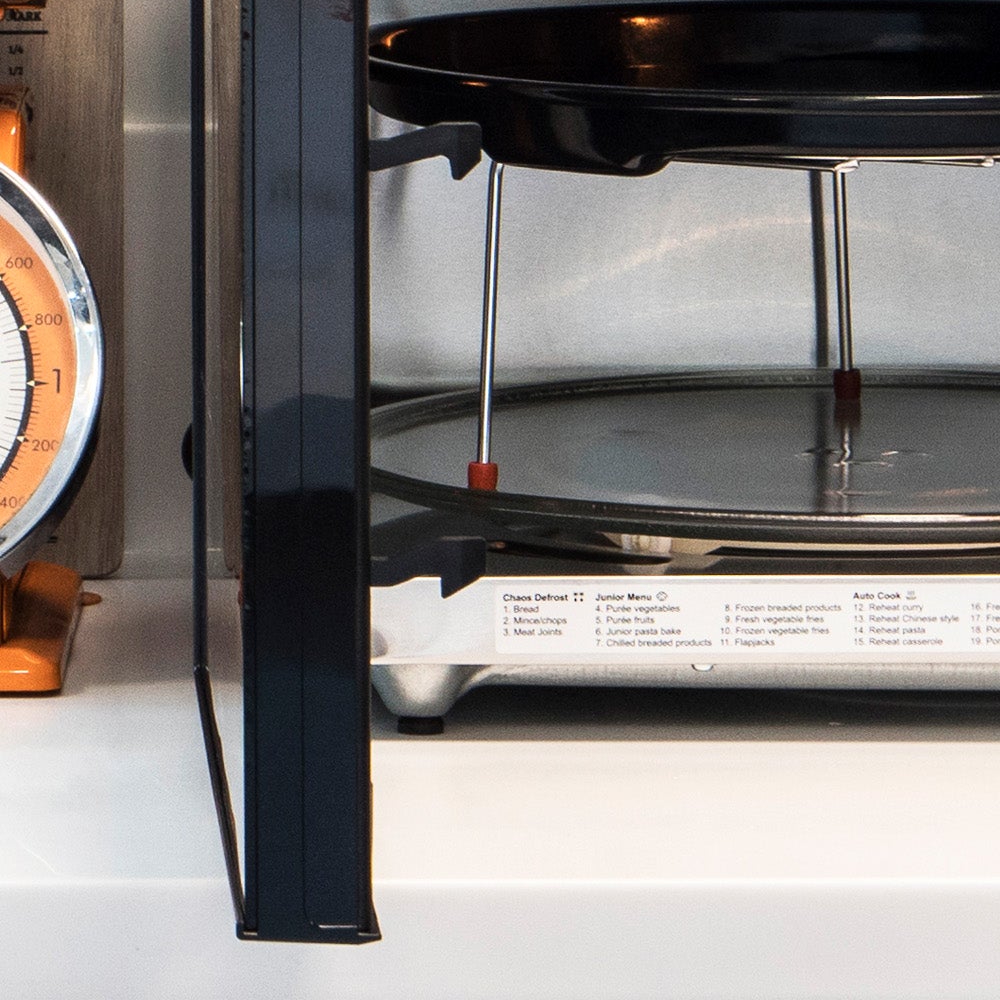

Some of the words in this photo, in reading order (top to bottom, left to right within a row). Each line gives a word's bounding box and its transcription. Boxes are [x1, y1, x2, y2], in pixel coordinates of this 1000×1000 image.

[6, 257, 33, 269] 600
[34, 313, 62, 326] 800
[52, 369, 61, 393] 1
[502, 593, 532, 602] Chaos
[534, 593, 569, 602] Defrost
[595, 592, 625, 602] Junior
[627, 592, 652, 602] Menu
[853, 592, 875, 600] Auto
[877, 592, 901, 600] Cook
[513, 604, 539, 614] Bread
[606, 604, 632, 613] Purée
[634, 604, 680, 614] vegetables
[735, 604, 765, 612] Frozen
[805, 604, 842, 613] products
[869, 603, 900, 611] Reheat
[513, 616, 568, 626] Mince/chops
[606, 616, 632, 624] Purée
[634, 616, 655, 624] fruits
[735, 615, 760, 623] Fresh
[763, 615, 804, 625] vegetable
[806, 615, 824, 623] fries
[869, 614, 900, 622] Reheat
[902, 614, 937, 622] Chinese
[940, 615, 959, 624] style
[514, 628, 535, 636] Meat
[634, 628, 658, 637] pasta
[736, 626, 765, 635] Frozen
[768, 627, 809, 636] vegetable
[869, 626, 900, 634] Reheat
[902, 626, 926, 635] pasta
[606, 638, 636, 647] Chilled
[638, 639, 673, 647] breaded
[675, 639, 712, 648] products
[734, 638, 775, 647] Flapjacks
